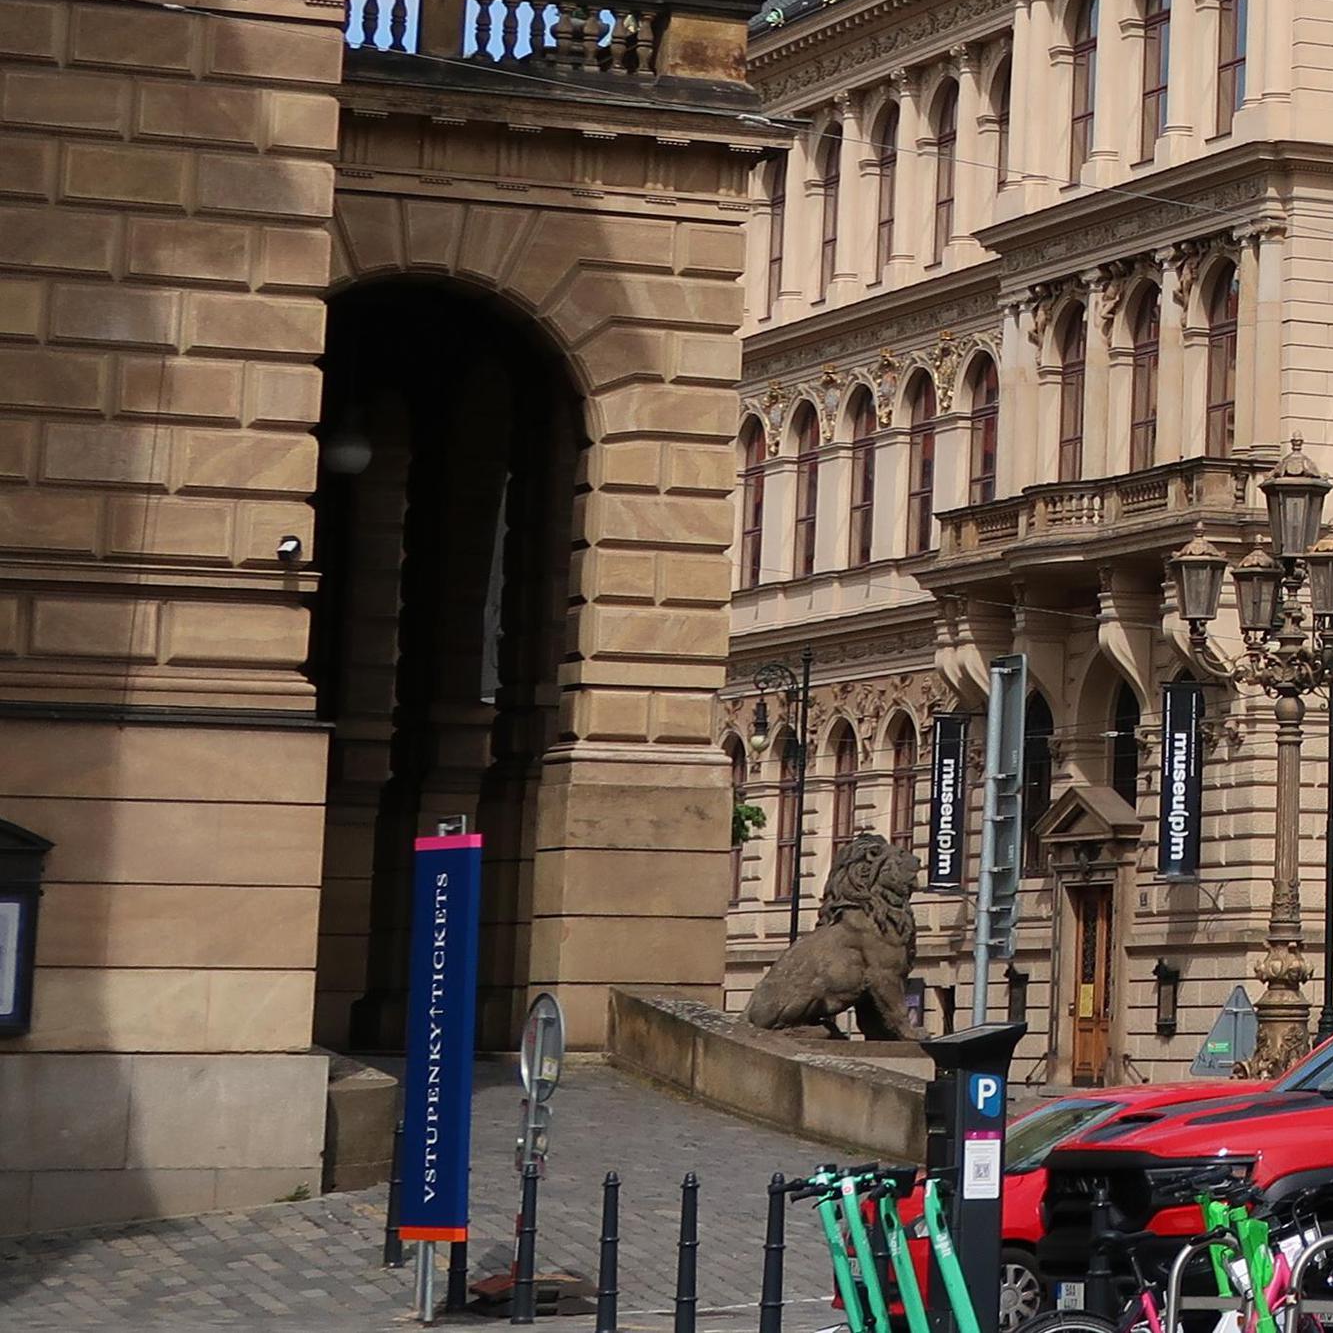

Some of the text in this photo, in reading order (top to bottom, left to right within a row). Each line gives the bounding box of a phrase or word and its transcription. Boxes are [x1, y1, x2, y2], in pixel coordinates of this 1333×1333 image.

[936, 758, 956, 875] museu(p)m
[1168, 732, 1189, 860] museu(p)m
[423, 871, 449, 1204] VSTUPENKY TICKETS
[977, 1077, 997, 1110] P
